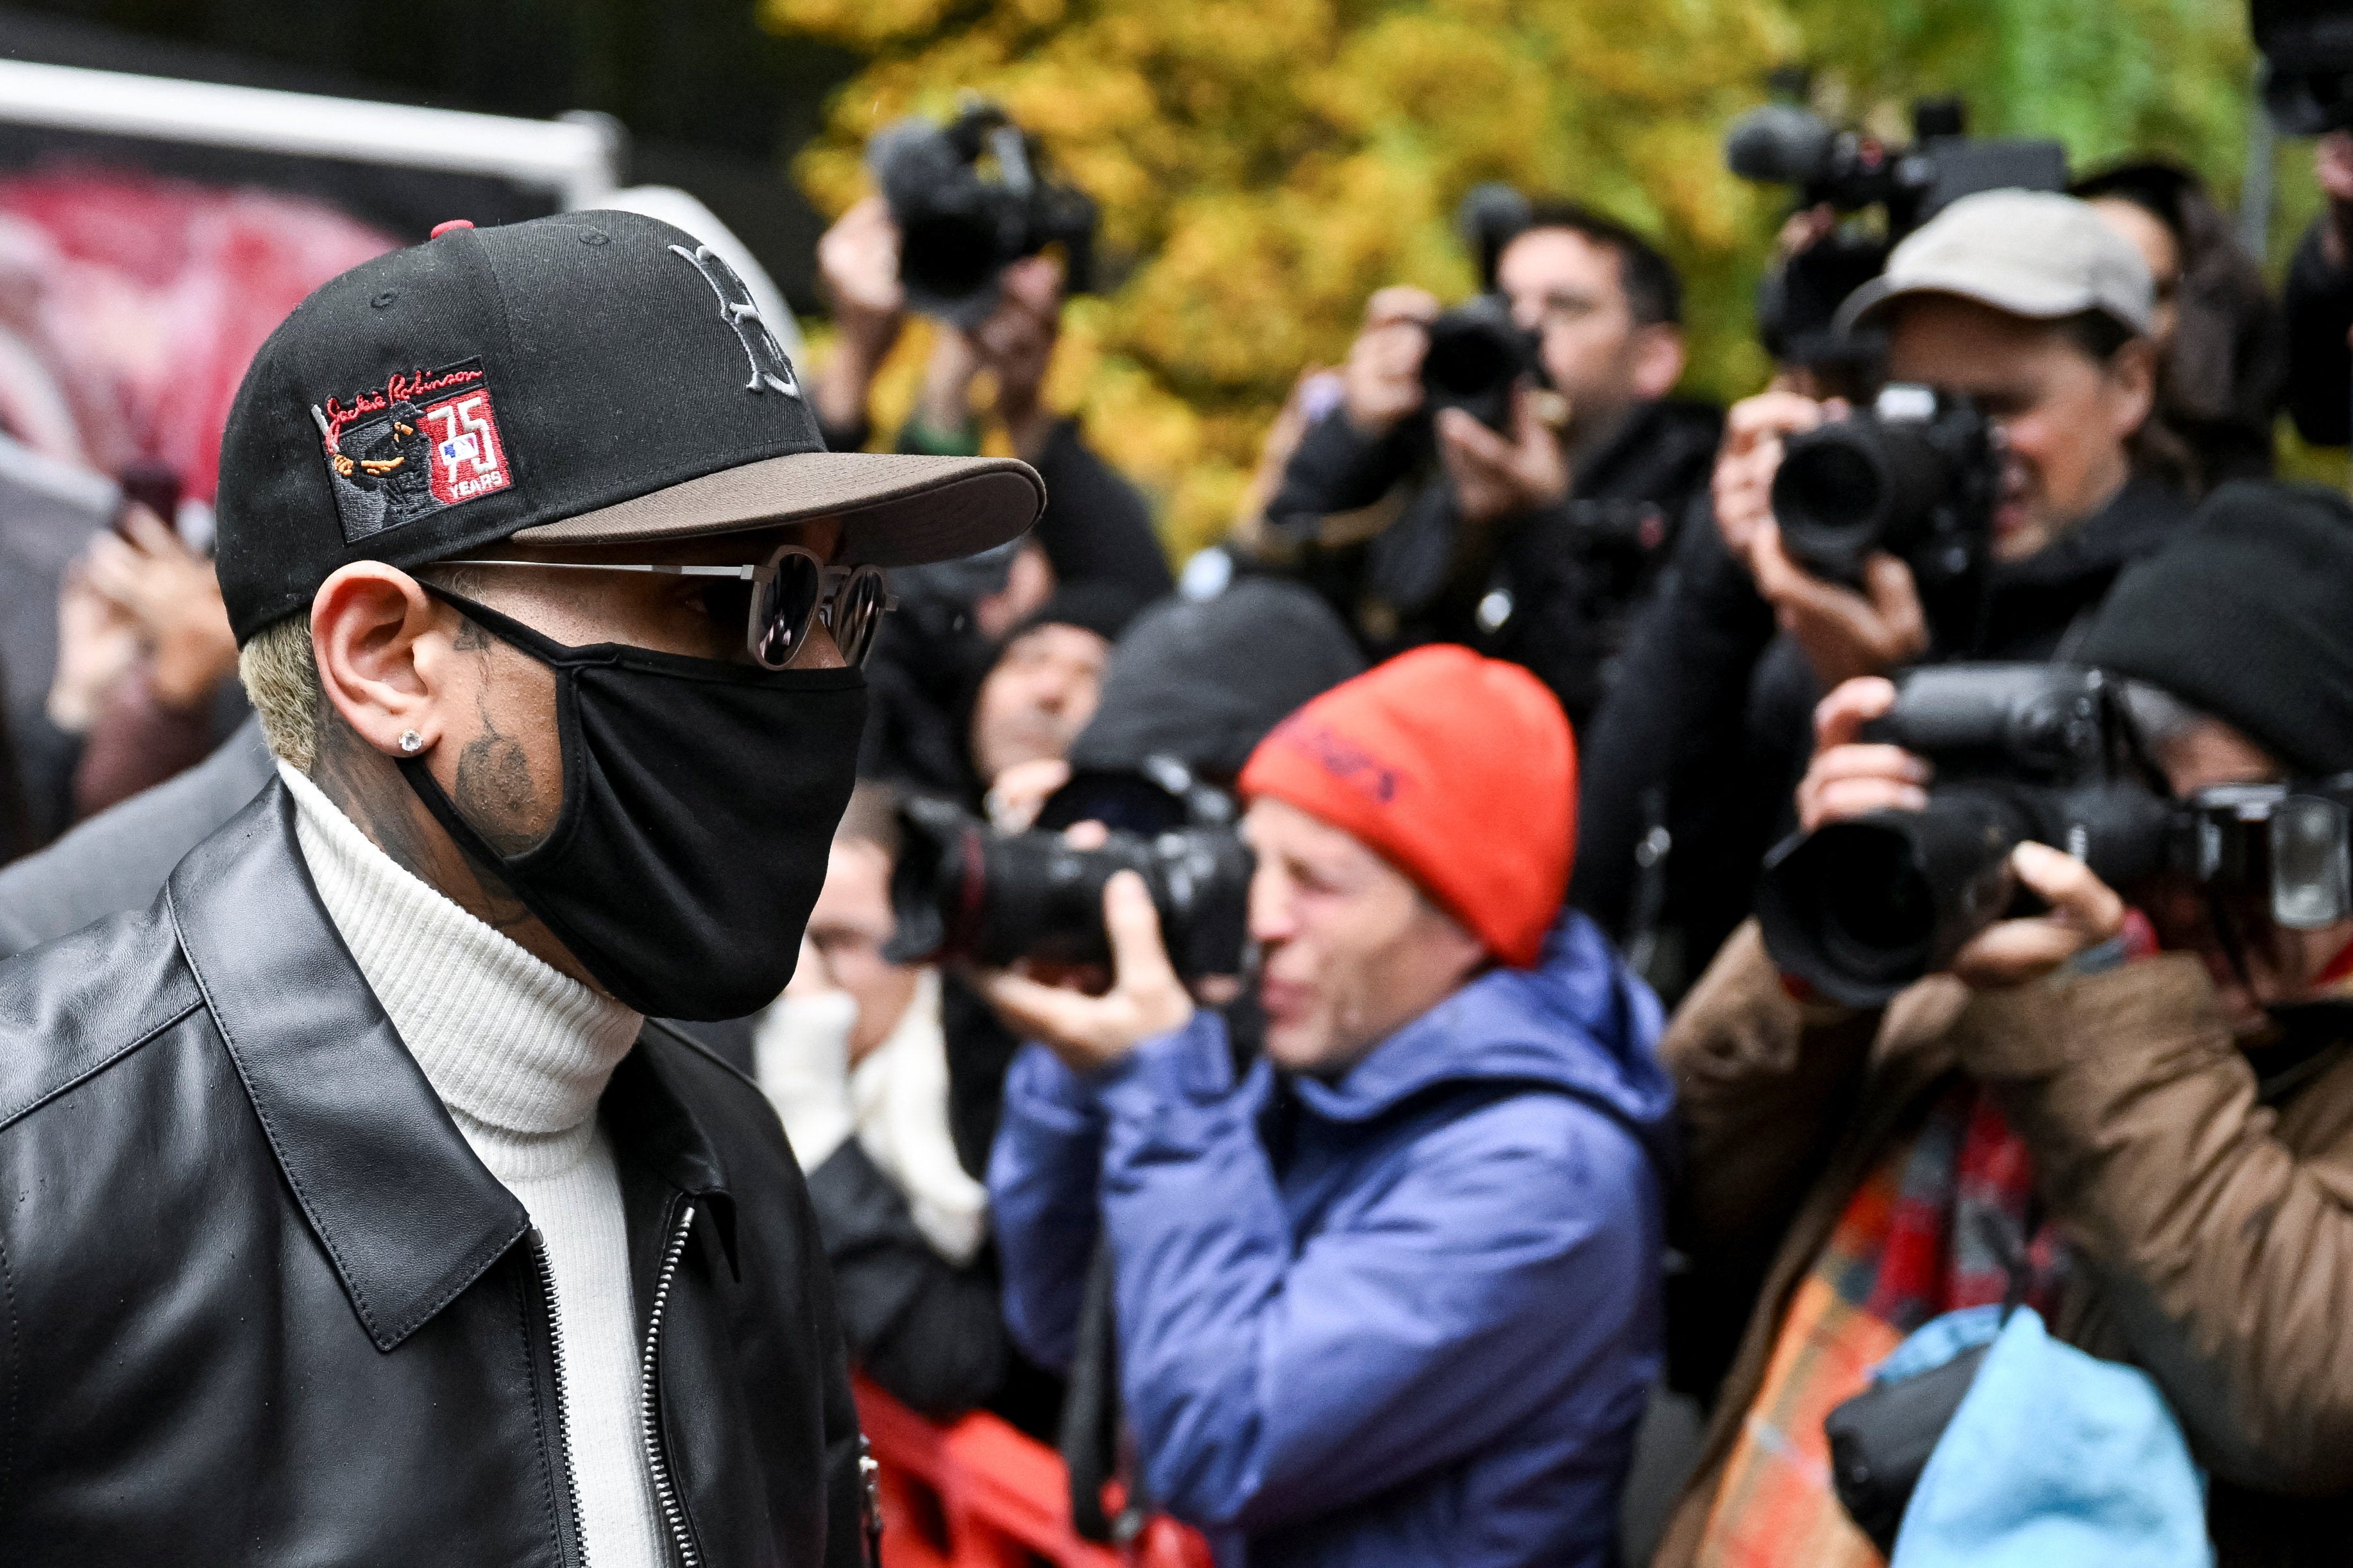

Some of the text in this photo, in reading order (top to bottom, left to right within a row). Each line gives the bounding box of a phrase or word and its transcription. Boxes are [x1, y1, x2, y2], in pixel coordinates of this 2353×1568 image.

[326, 370, 483, 455] Jackie Robinson
[427, 396, 498, 482] 75
[450, 471, 503, 498] YEARS
